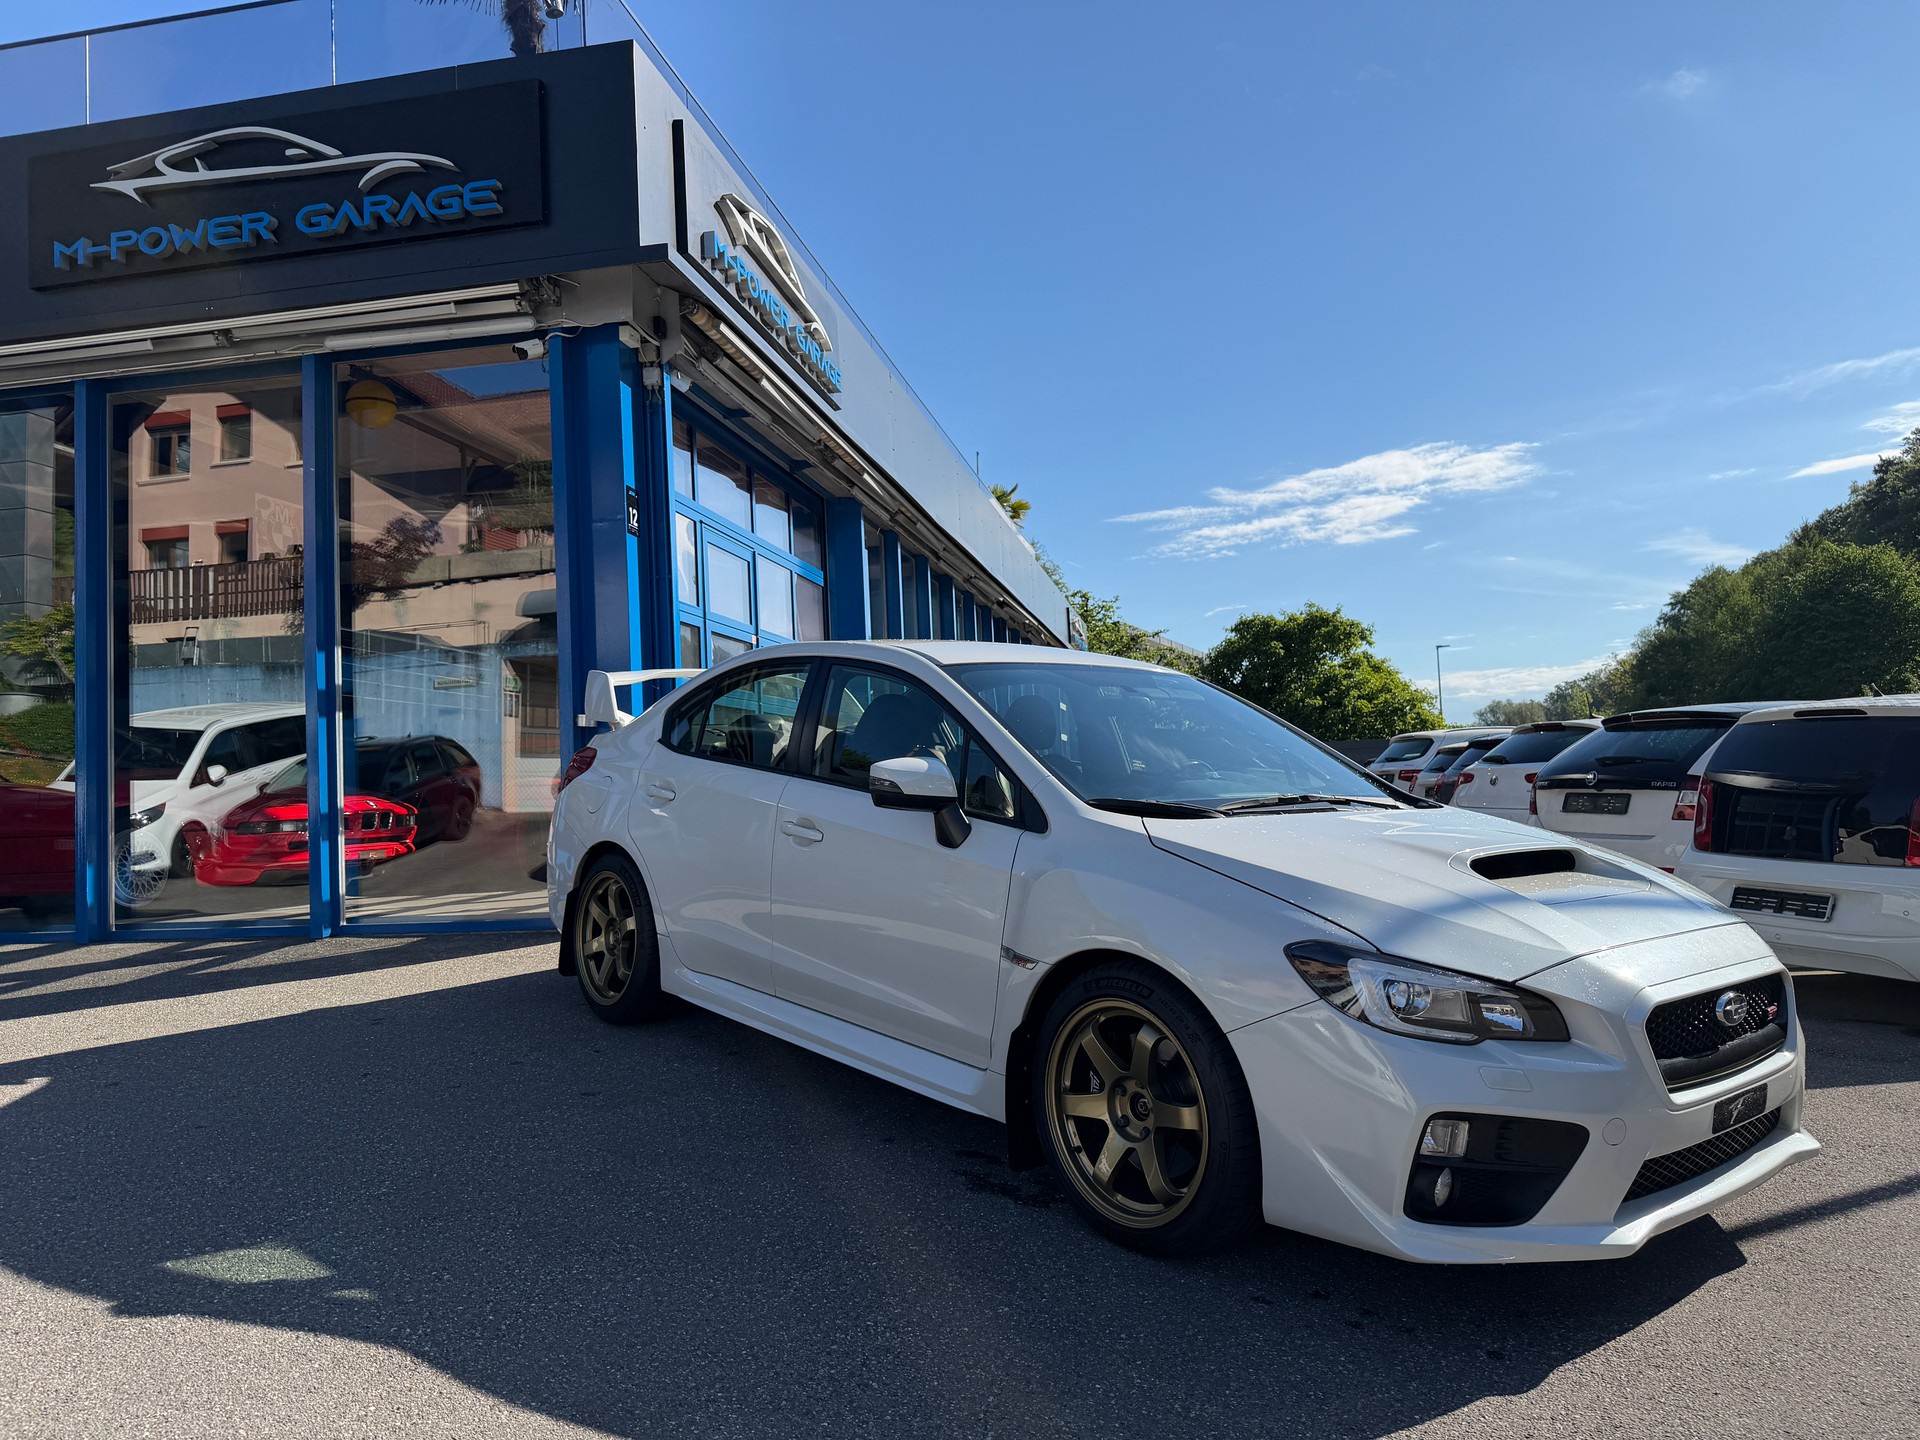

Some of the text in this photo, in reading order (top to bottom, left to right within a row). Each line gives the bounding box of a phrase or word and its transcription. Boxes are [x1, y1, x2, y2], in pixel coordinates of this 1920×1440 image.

[54, 178, 500, 269] M-POWER GARAGE
[713, 230, 843, 393] M-POWER GARAGE
[627, 506, 638, 526] 12
[1650, 780, 1677, 788] RAPID
[1099, 977, 1153, 998] MICHELIN
